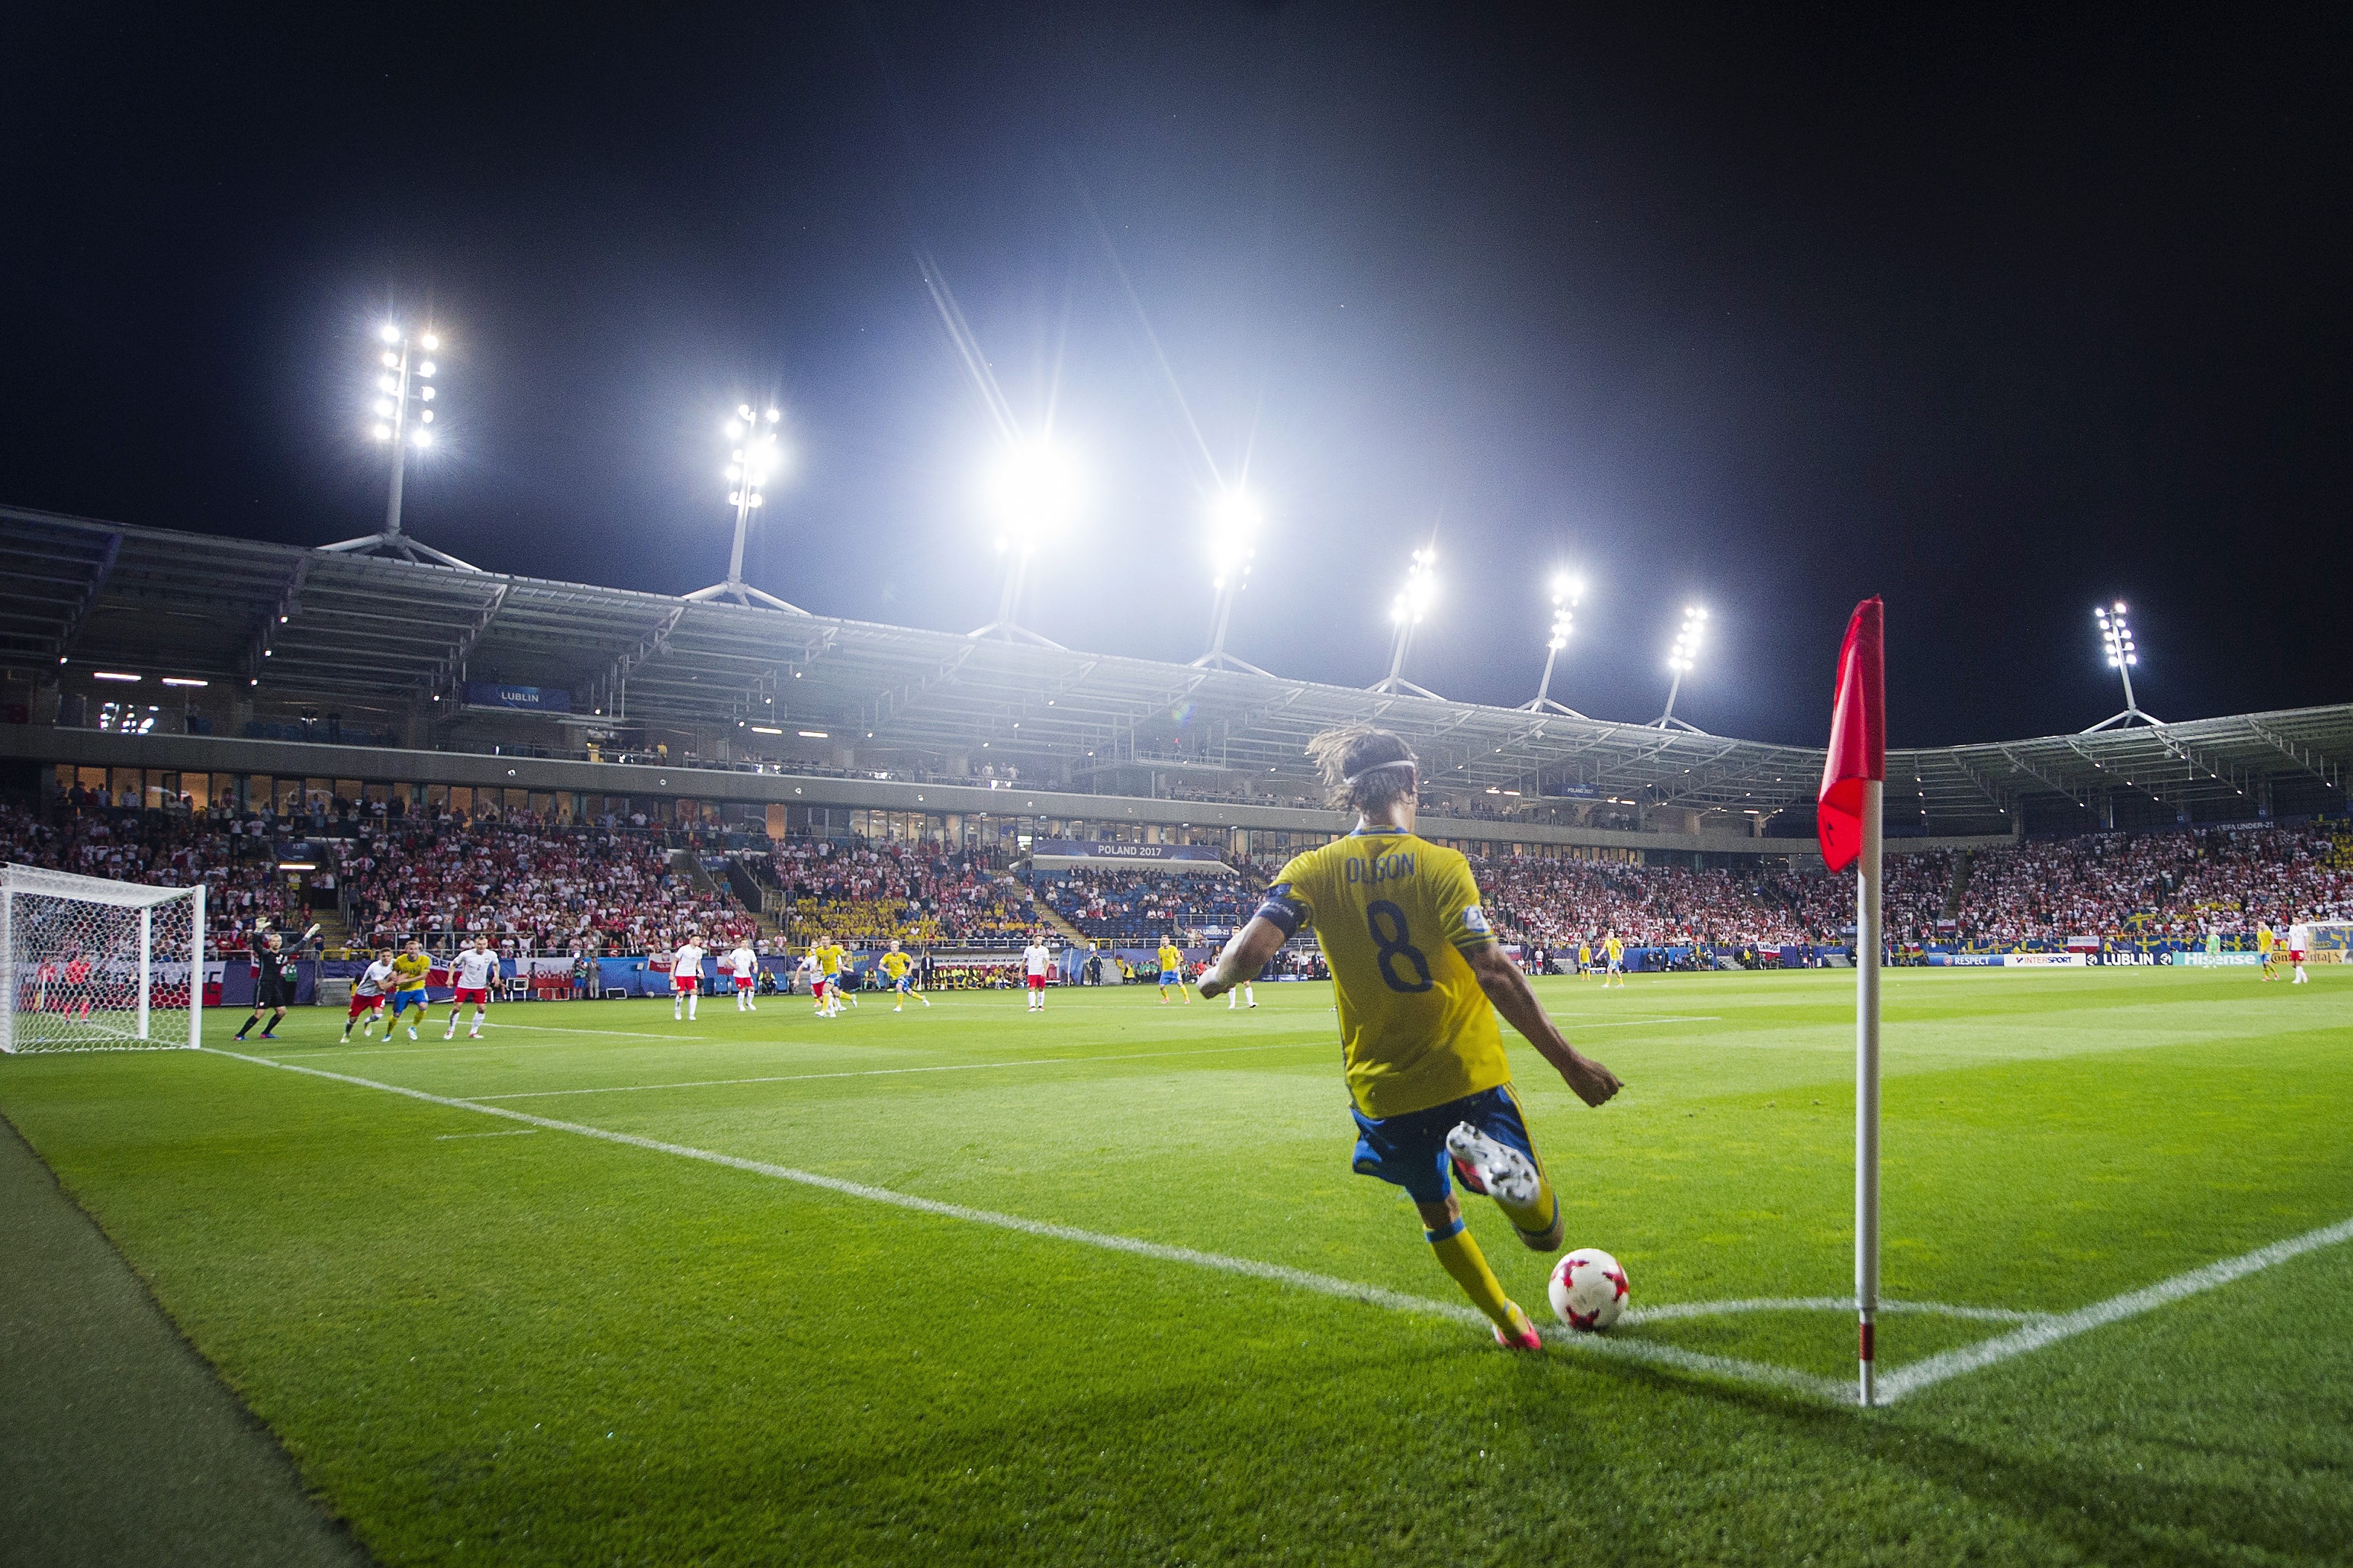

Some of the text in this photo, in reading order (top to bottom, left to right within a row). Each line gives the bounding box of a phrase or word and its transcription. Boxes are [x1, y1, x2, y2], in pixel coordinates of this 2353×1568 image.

[501, 691, 539, 702] LUBLIN
[2237, 821, 2274, 830] UNDER-21
[1098, 845, 1161, 856] POLAND 2017
[1366, 899, 1434, 993] 8
[1955, 956, 1990, 965] RESPECT
[2103, 953, 2154, 965] LUBLIN
[2184, 952, 2256, 965] Hisense
